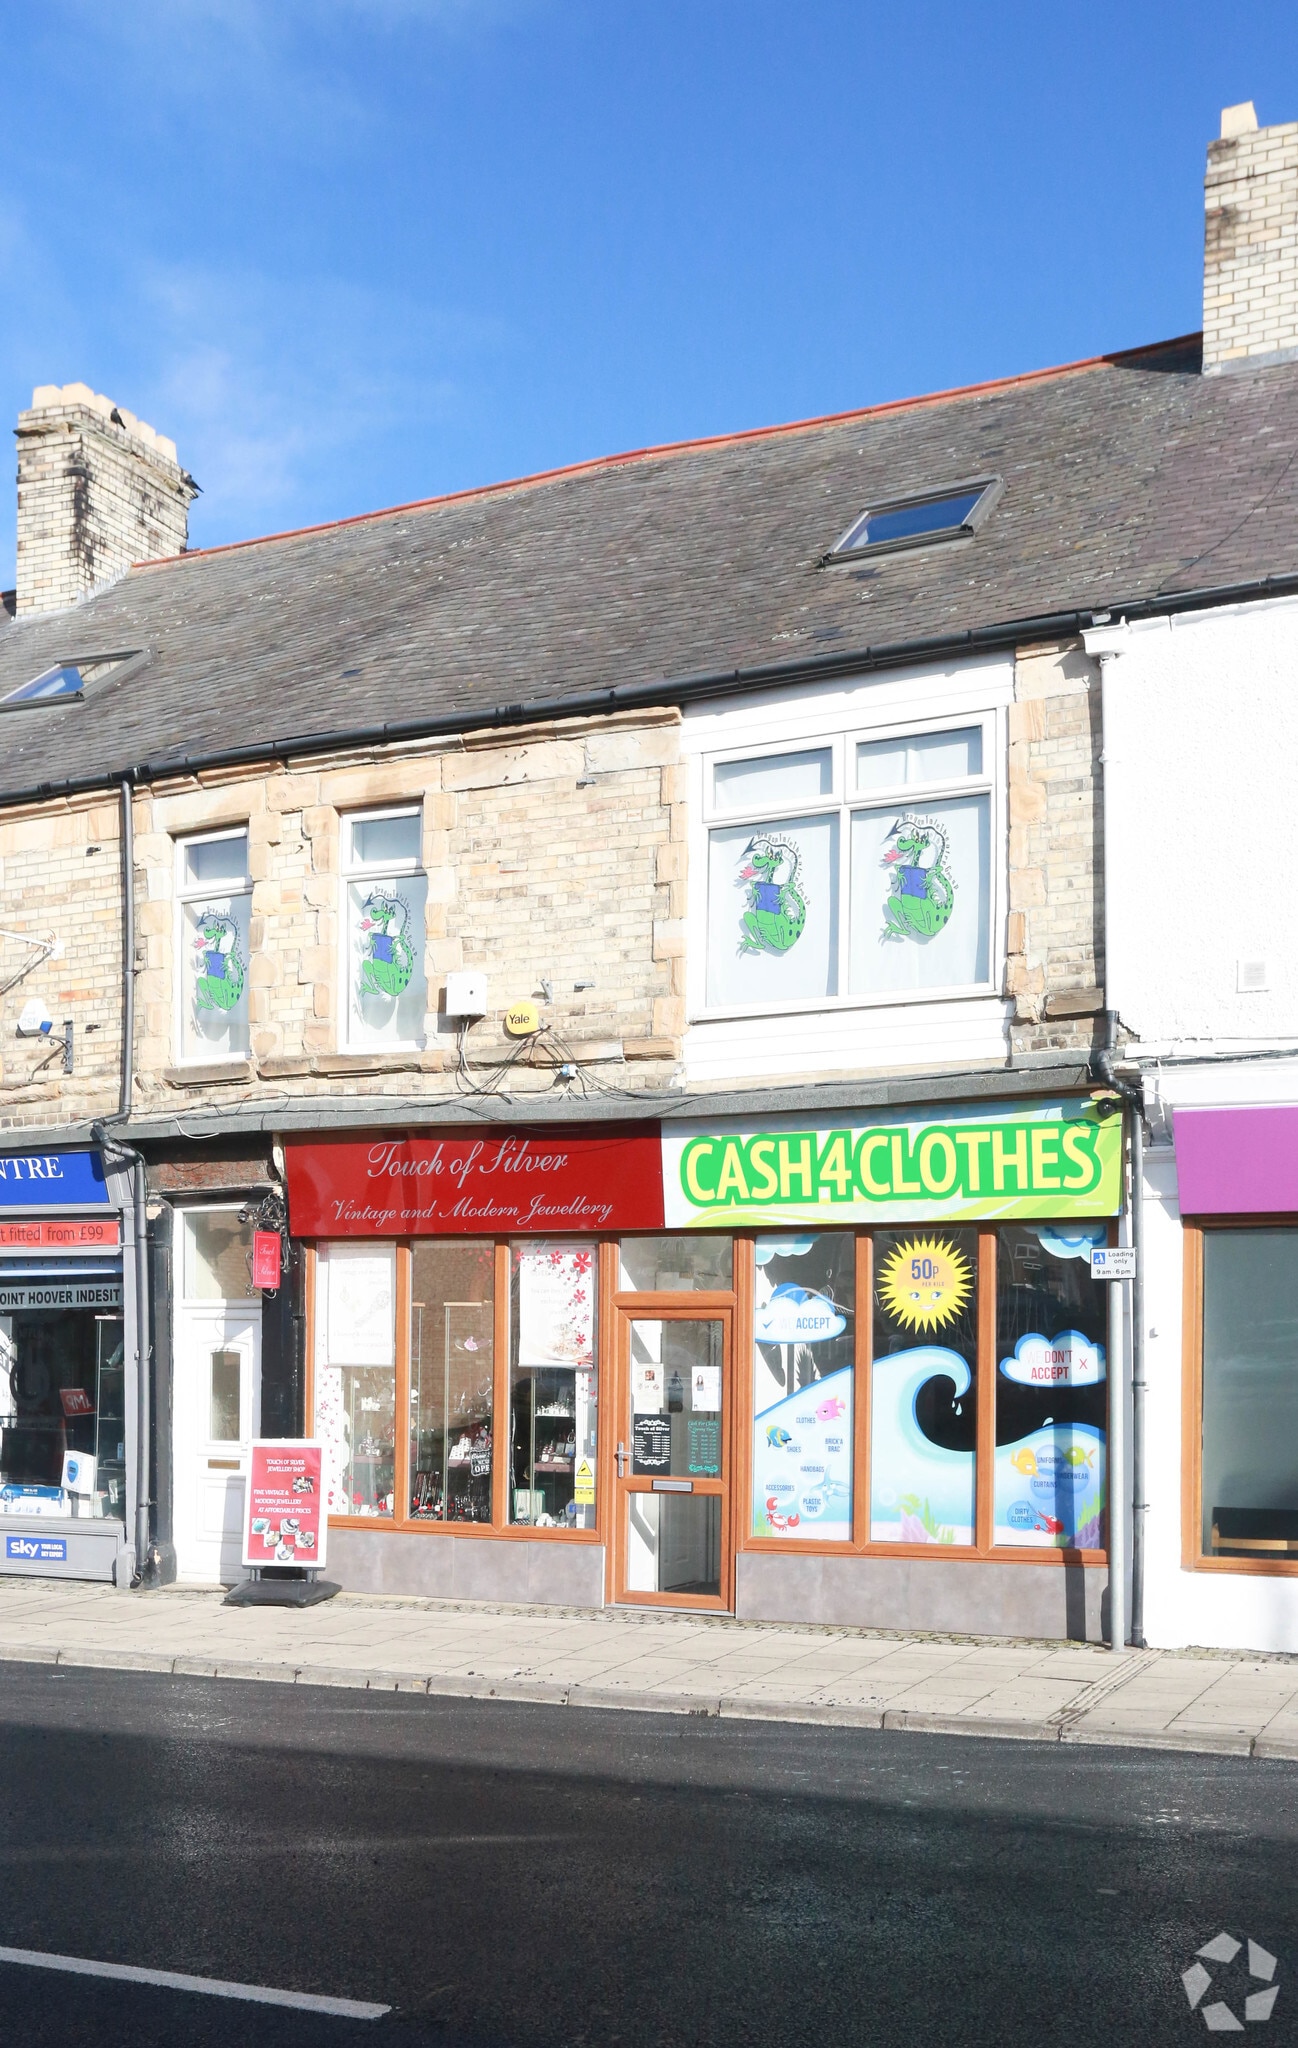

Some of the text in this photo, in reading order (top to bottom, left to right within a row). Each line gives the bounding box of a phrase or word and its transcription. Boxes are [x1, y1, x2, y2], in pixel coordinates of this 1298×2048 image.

[509, 1014, 530, 1024] Yale
[367, 1135, 568, 1188] Touch of Silver
[684, 1124, 1097, 1202] CASH4CLOTHES
[331, 1194, 613, 1226] Vintage and Modern Jewellery
[9, 1227, 41, 1242] fitted
[47, 1226, 75, 1241] from
[80, 1225, 104, 1241] £99
[0, 1288, 121, 1305] OINT HOOVER INDESIT
[796, 1317, 831, 1329] ACCEPT
[1044, 1350, 1073, 1364] DON'T
[1031, 1366, 1069, 1380] ACCEPT
[800, 1465, 825, 1473] HANDBAGS
[1054, 1472, 1089, 1480] UNDERWEAR
[1033, 1480, 1058, 1488] CURTAINS
[1014, 1507, 1029, 1515] DIRTY
[10, 1539, 40, 1558] sky
